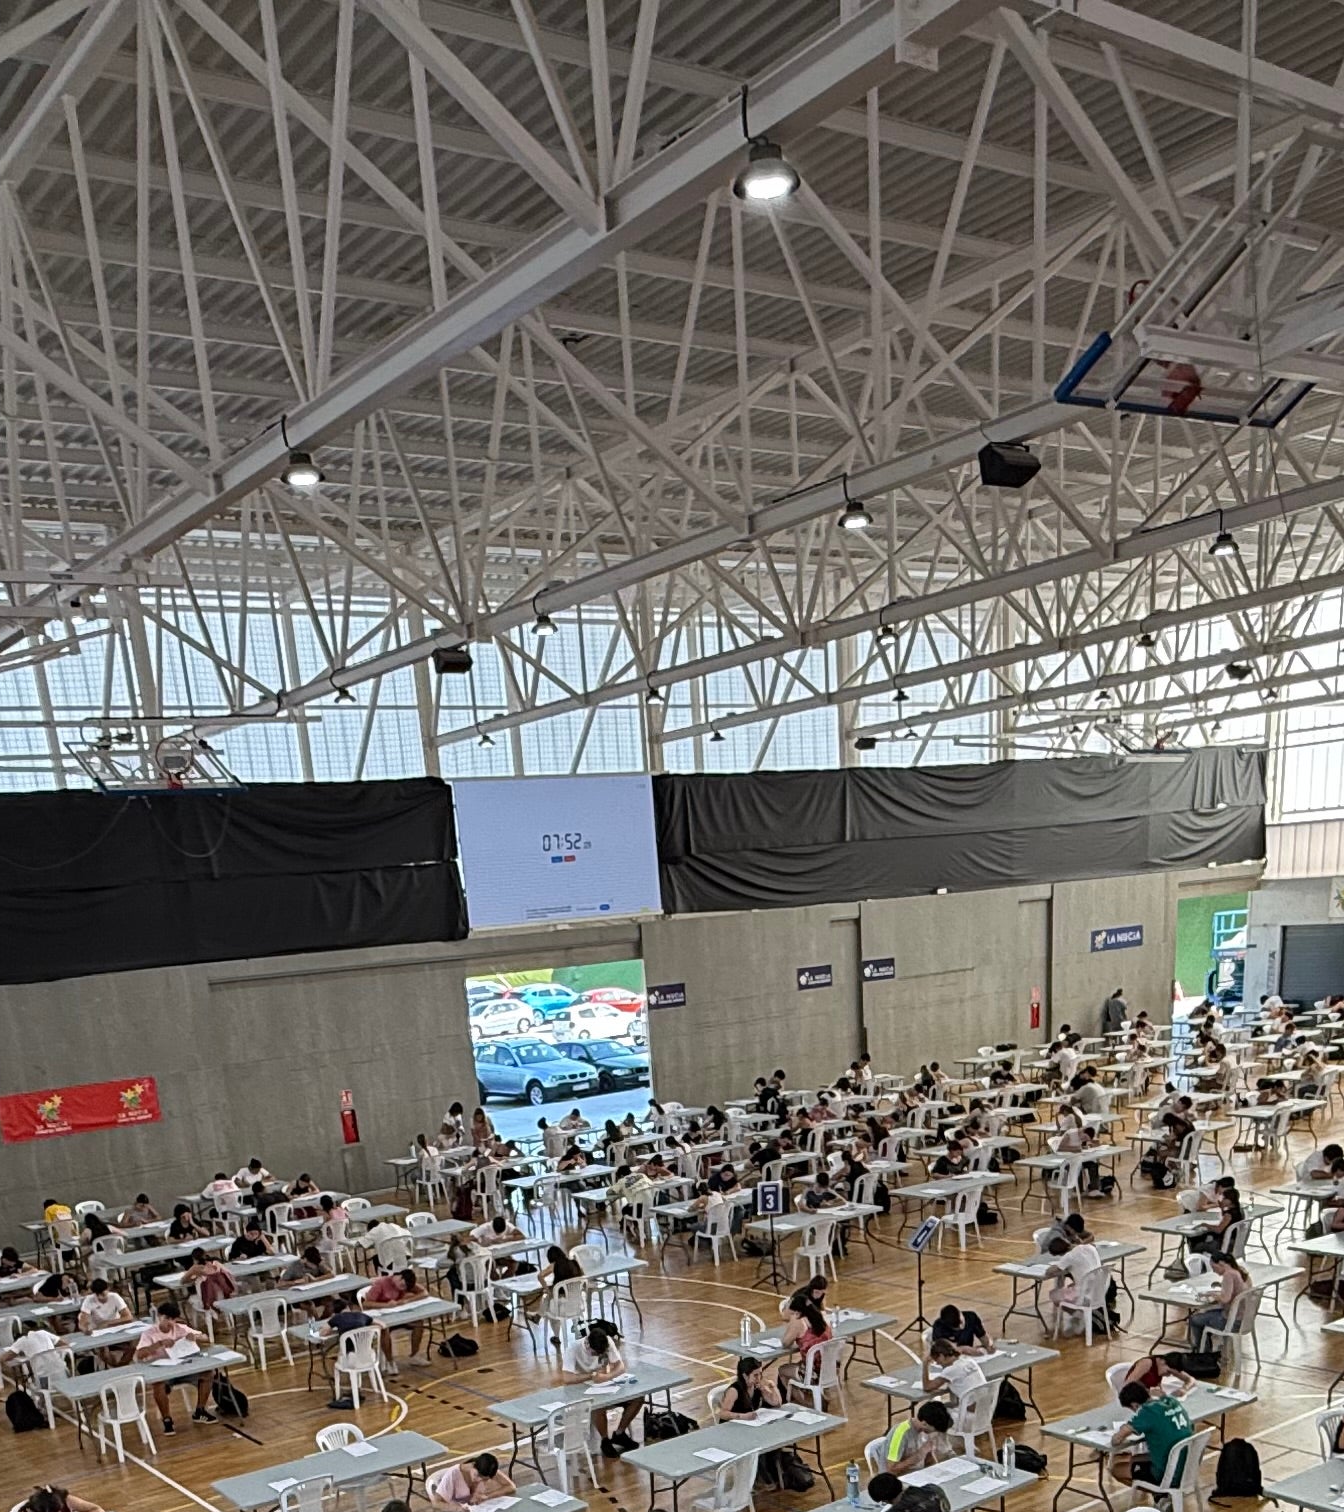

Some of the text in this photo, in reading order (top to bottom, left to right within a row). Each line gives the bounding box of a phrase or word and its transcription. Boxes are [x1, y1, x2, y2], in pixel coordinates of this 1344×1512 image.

[542, 832, 582, 851] 07:52
[766, 1194, 775, 1209] 3
[1171, 1413, 1188, 1430] 14
